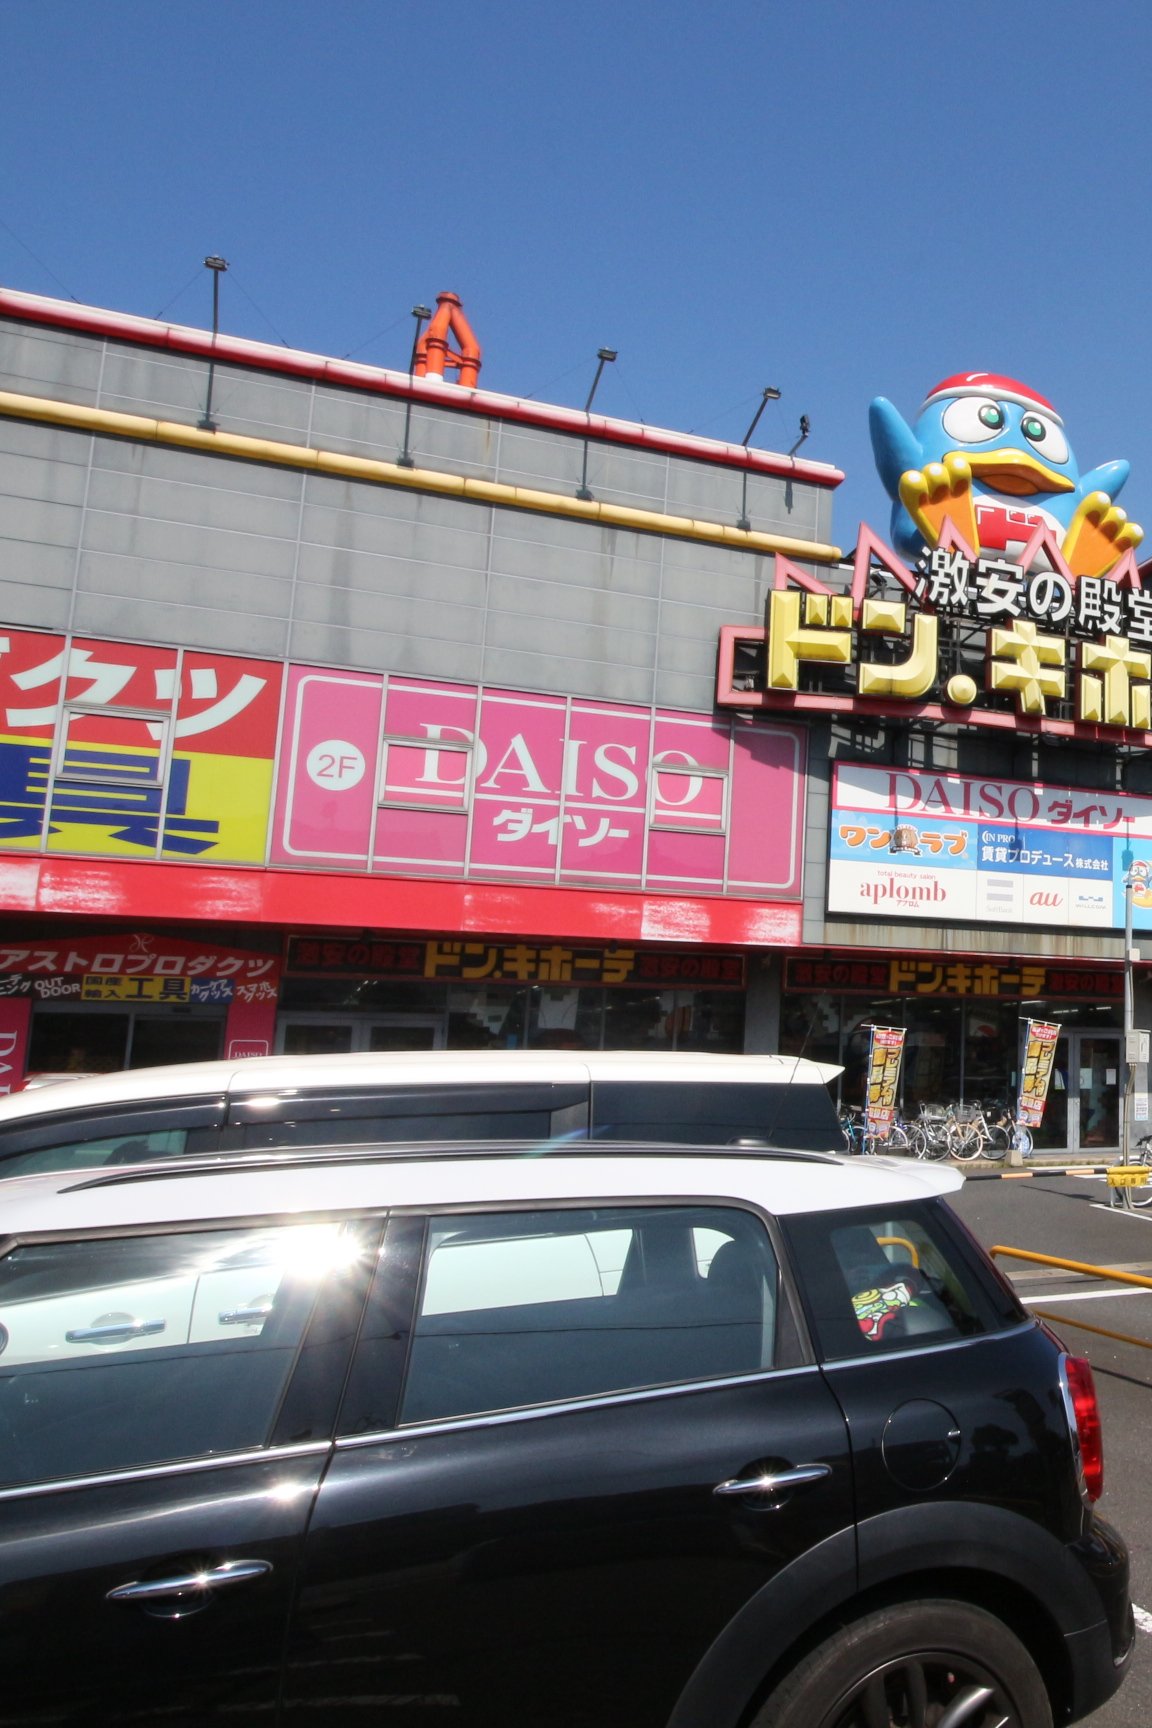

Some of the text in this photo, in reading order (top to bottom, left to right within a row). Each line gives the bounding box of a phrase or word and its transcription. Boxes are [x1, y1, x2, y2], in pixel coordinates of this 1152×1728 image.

[0, 637, 267, 741] クツ
[317, 754, 358, 779] 2F
[415, 722, 703, 807] DAISO
[885, 771, 1040, 823] DAISO
[493, 808, 630, 848] ダイソー
[1047, 800, 1136, 829] ダイソー
[894, 871, 917, 879] beauty
[859, 877, 947, 905] aplomb
[1029, 891, 1064, 907] au
[0, 950, 275, 978] アストロプロダクツ
[34, 976, 64, 991] OUT
[40, 983, 81, 998] DOOR
[126, 977, 188, 1001] 工具
